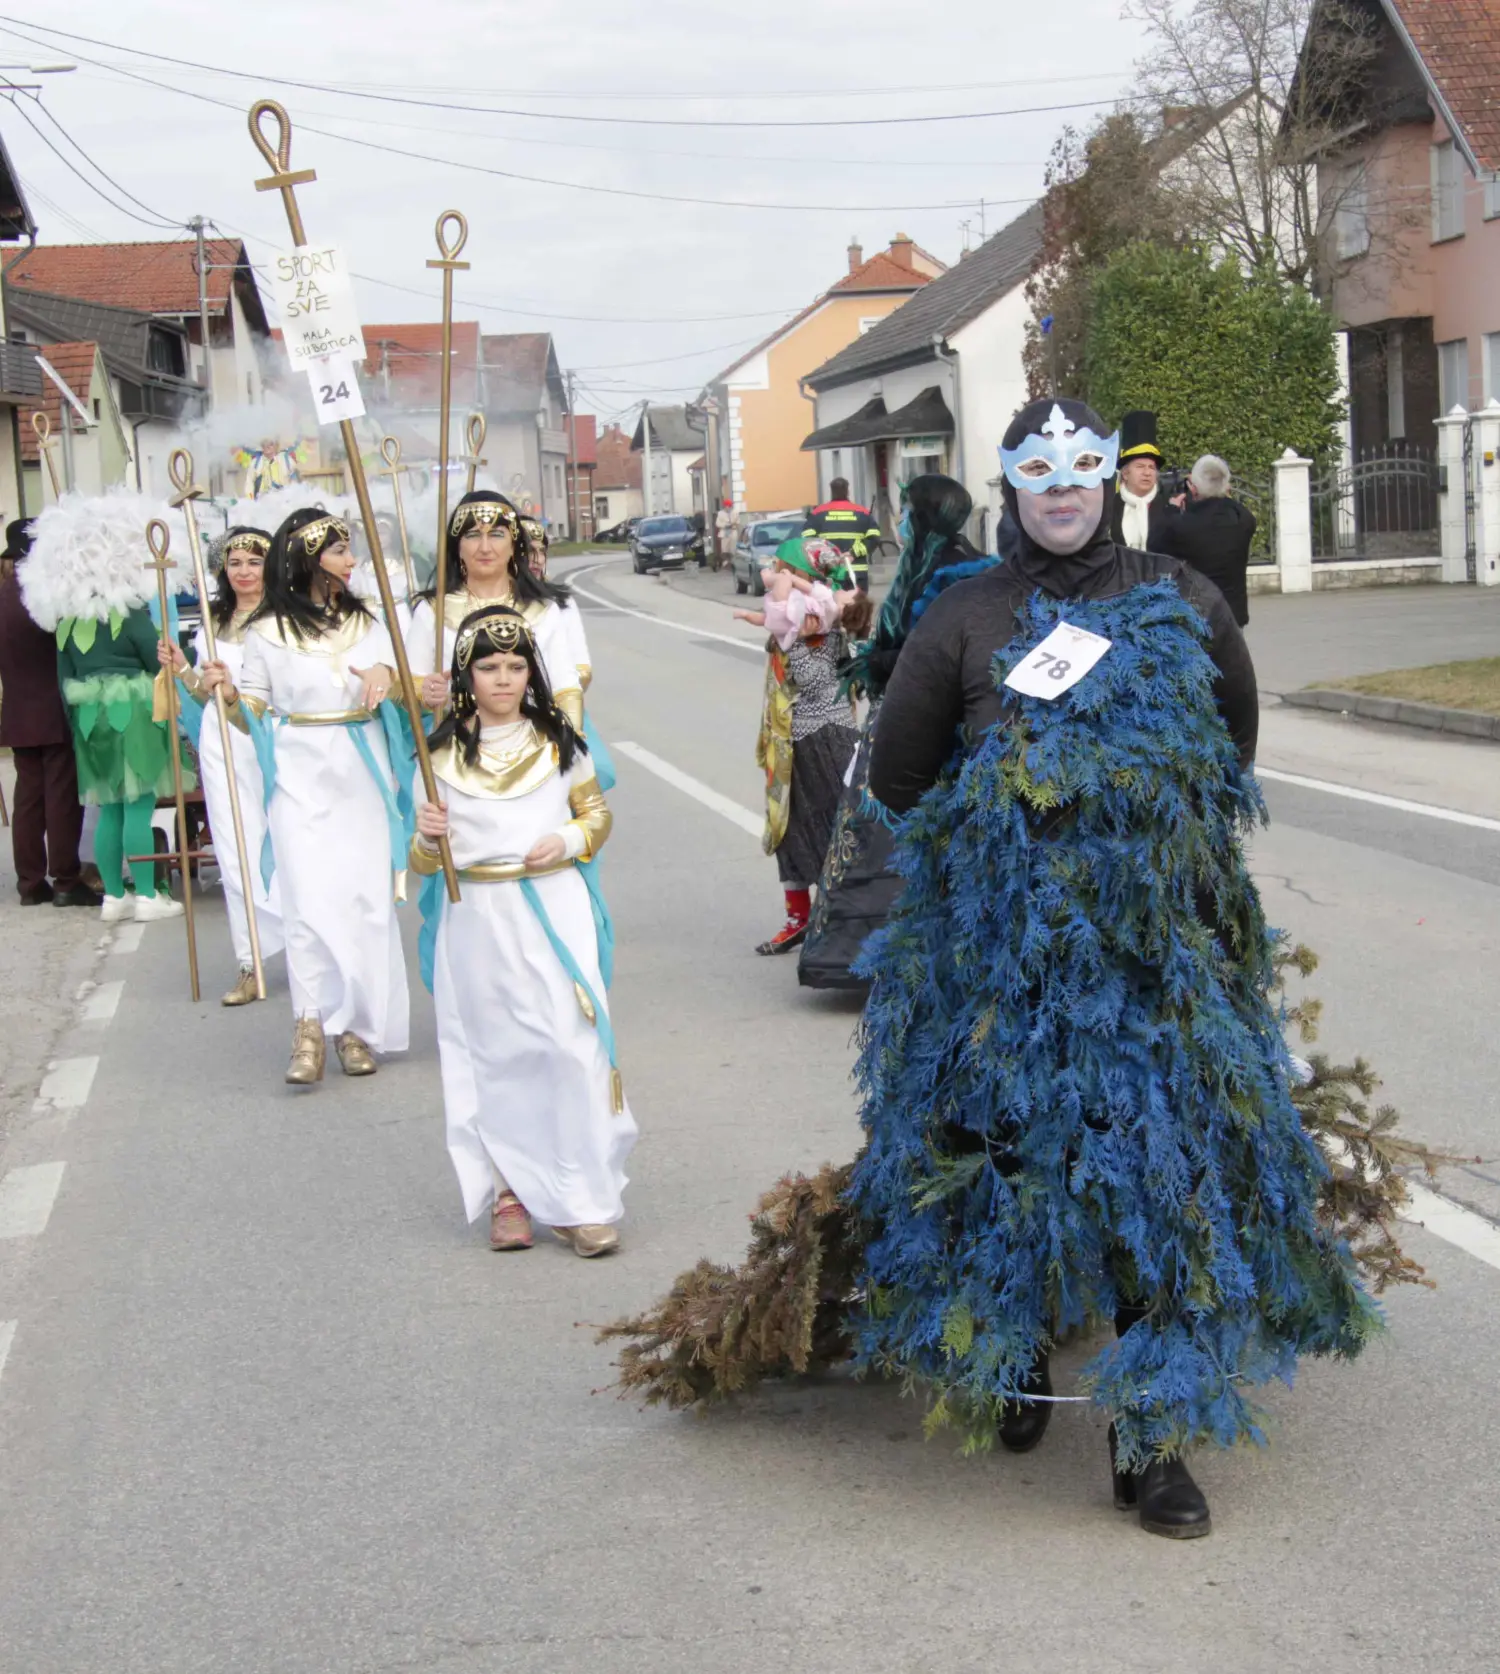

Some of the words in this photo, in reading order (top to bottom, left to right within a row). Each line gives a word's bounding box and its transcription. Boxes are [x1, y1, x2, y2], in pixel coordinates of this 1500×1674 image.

[277, 249, 336, 282] SPORT
[296, 279, 321, 298] ZA
[287, 294, 331, 318] SVE
[295, 334, 359, 358] SUBOTICA
[303, 328, 331, 341] MALA
[319, 381, 350, 405] 24
[1032, 652, 1071, 680] 78
